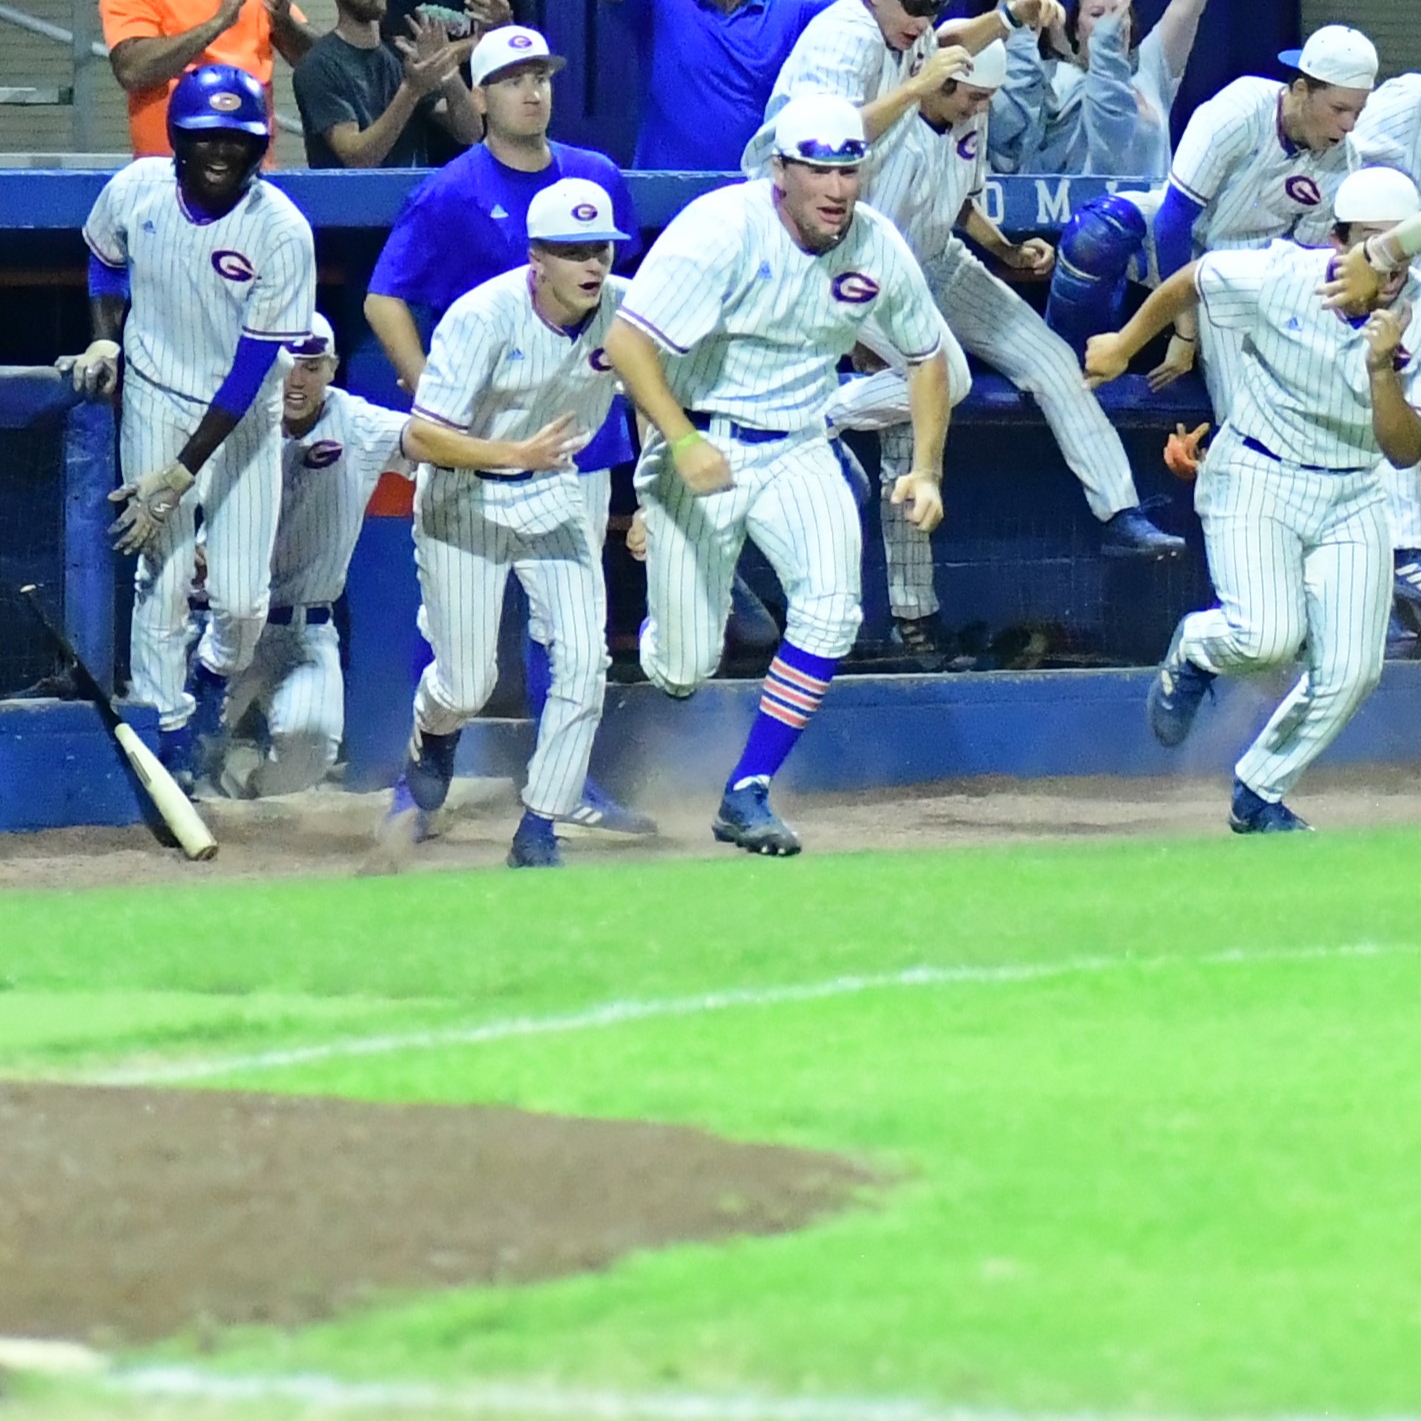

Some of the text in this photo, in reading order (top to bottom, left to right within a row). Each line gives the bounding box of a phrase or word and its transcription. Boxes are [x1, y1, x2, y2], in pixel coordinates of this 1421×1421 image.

[1285, 175, 1322, 206] G
[211, 249, 256, 282] G
[832, 271, 880, 303] G
